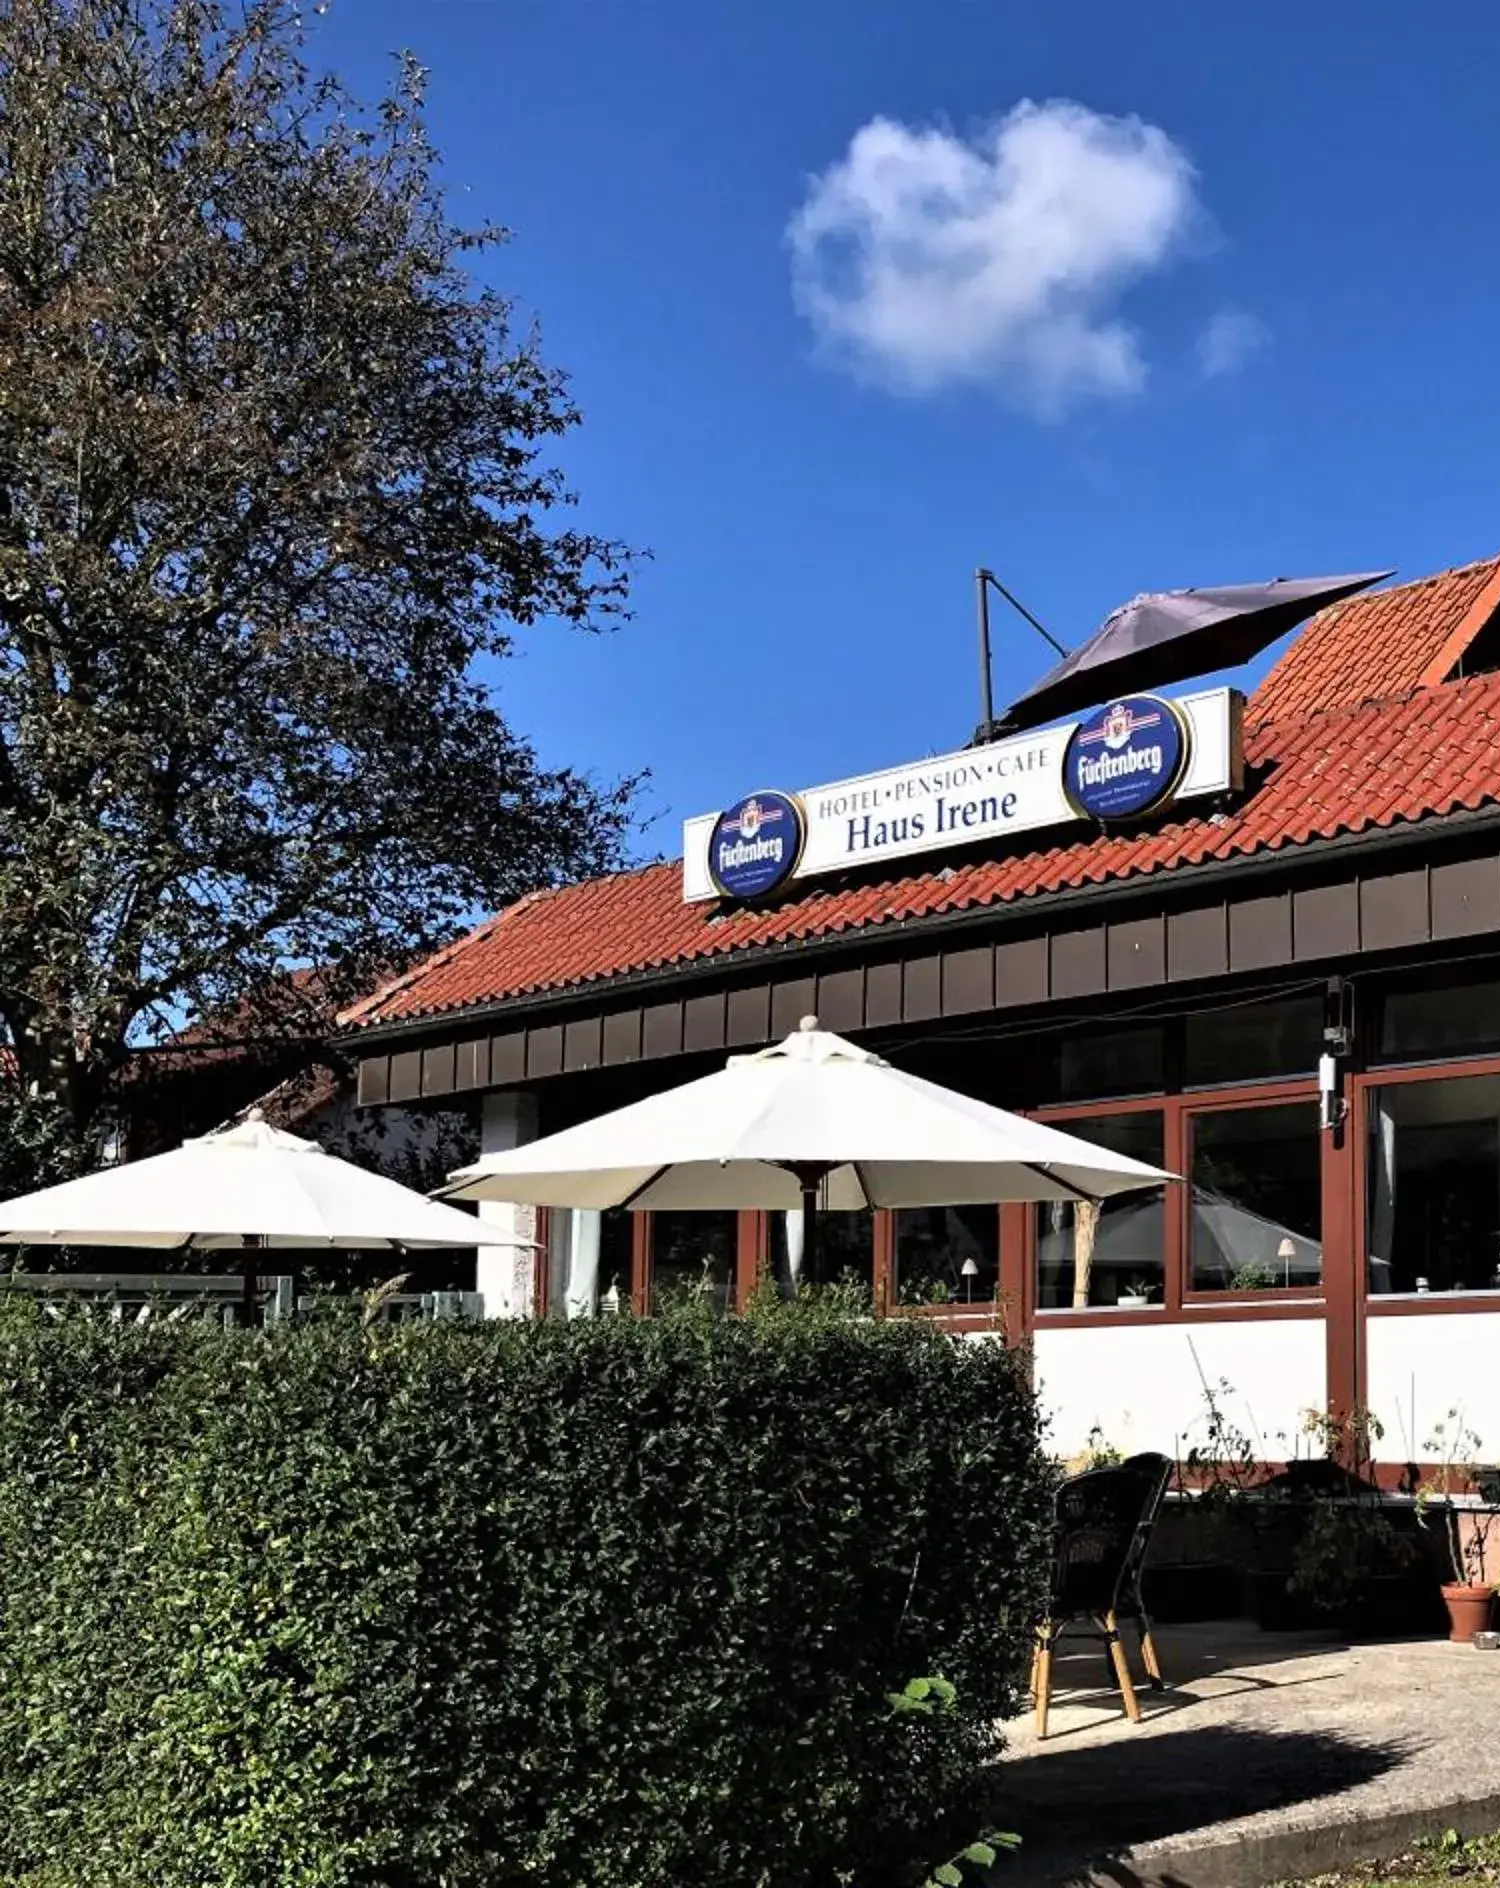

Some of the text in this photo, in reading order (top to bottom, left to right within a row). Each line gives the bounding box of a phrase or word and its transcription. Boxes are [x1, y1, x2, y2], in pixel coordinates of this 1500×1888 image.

[819, 788, 881, 819] HOTEL
[895, 765, 983, 801] PENSION
[846, 791, 1017, 852] Haus Irene
